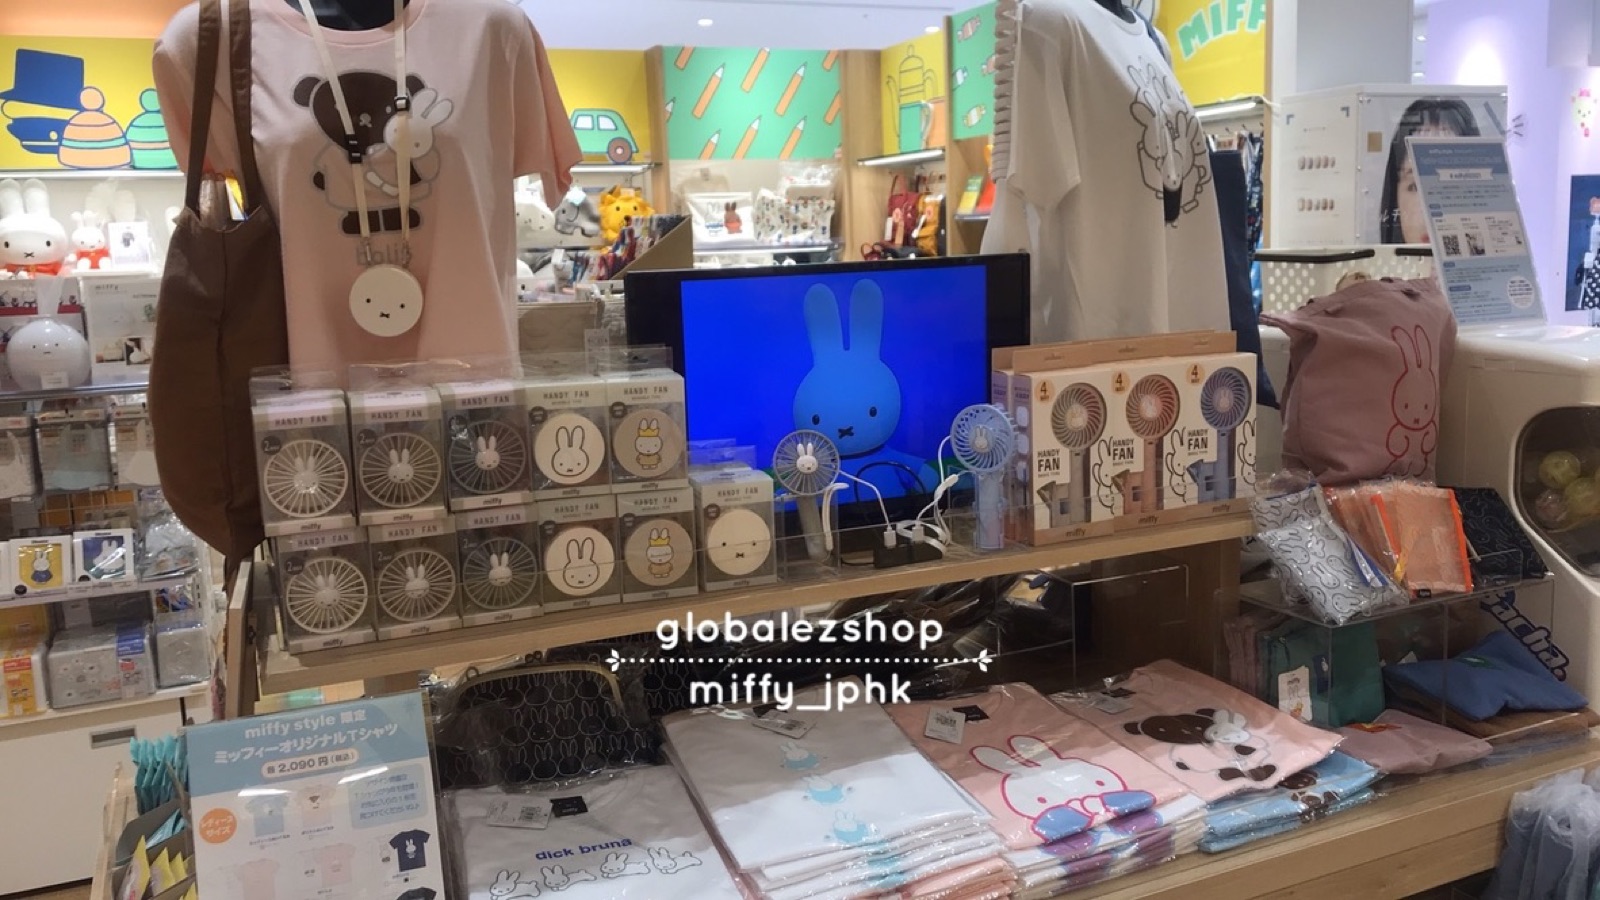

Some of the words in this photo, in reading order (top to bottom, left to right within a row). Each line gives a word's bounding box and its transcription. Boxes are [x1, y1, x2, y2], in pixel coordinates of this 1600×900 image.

[1191, 365, 1199, 378] 4
[1115, 372, 1123, 386] 4
[624, 386, 649, 396] HANDY
[653, 386, 668, 394] FAN
[1040, 381, 1048, 394] 4
[461, 397, 489, 406] HANDY
[493, 395, 510, 404] FAN
[543, 391, 569, 400] HANDY
[574, 390, 590, 399] FAN
[275, 416, 307, 427] HANDY
[310, 414, 328, 424] FAN
[371, 411, 400, 420] HANDY
[406, 409, 422, 419] FAN
[1188, 429, 1208, 437] HANDY
[1113, 438, 1135, 447] HANDY
[1188, 437, 1208, 451] FAN
[1113, 447, 1134, 460] FAN
[1038, 457, 1060, 472] FAN
[717, 488, 740, 498] HANDY
[744, 487, 759, 496] FAN
[634, 497, 658, 507] HANDY
[663, 496, 678, 504] FAN
[554, 503, 579, 514] HANDY
[585, 502, 599, 512] FAN
[1212, 503, 1231, 513] miffy
[473, 515, 500, 525] HANDY
[504, 513, 522, 522] FAN
[1138, 515, 1158, 525] miffy
[388, 526, 417, 537] HANDY
[421, 525, 438, 533] FAN
[1065, 527, 1086, 538] miffy
[297, 536, 326, 547] HANDY
[332, 534, 349, 543] FAN
[244, 719, 291, 739] miffy
[294, 713, 336, 732] style
[535, 847, 575, 861] dick
[579, 837, 633, 855] bruna
